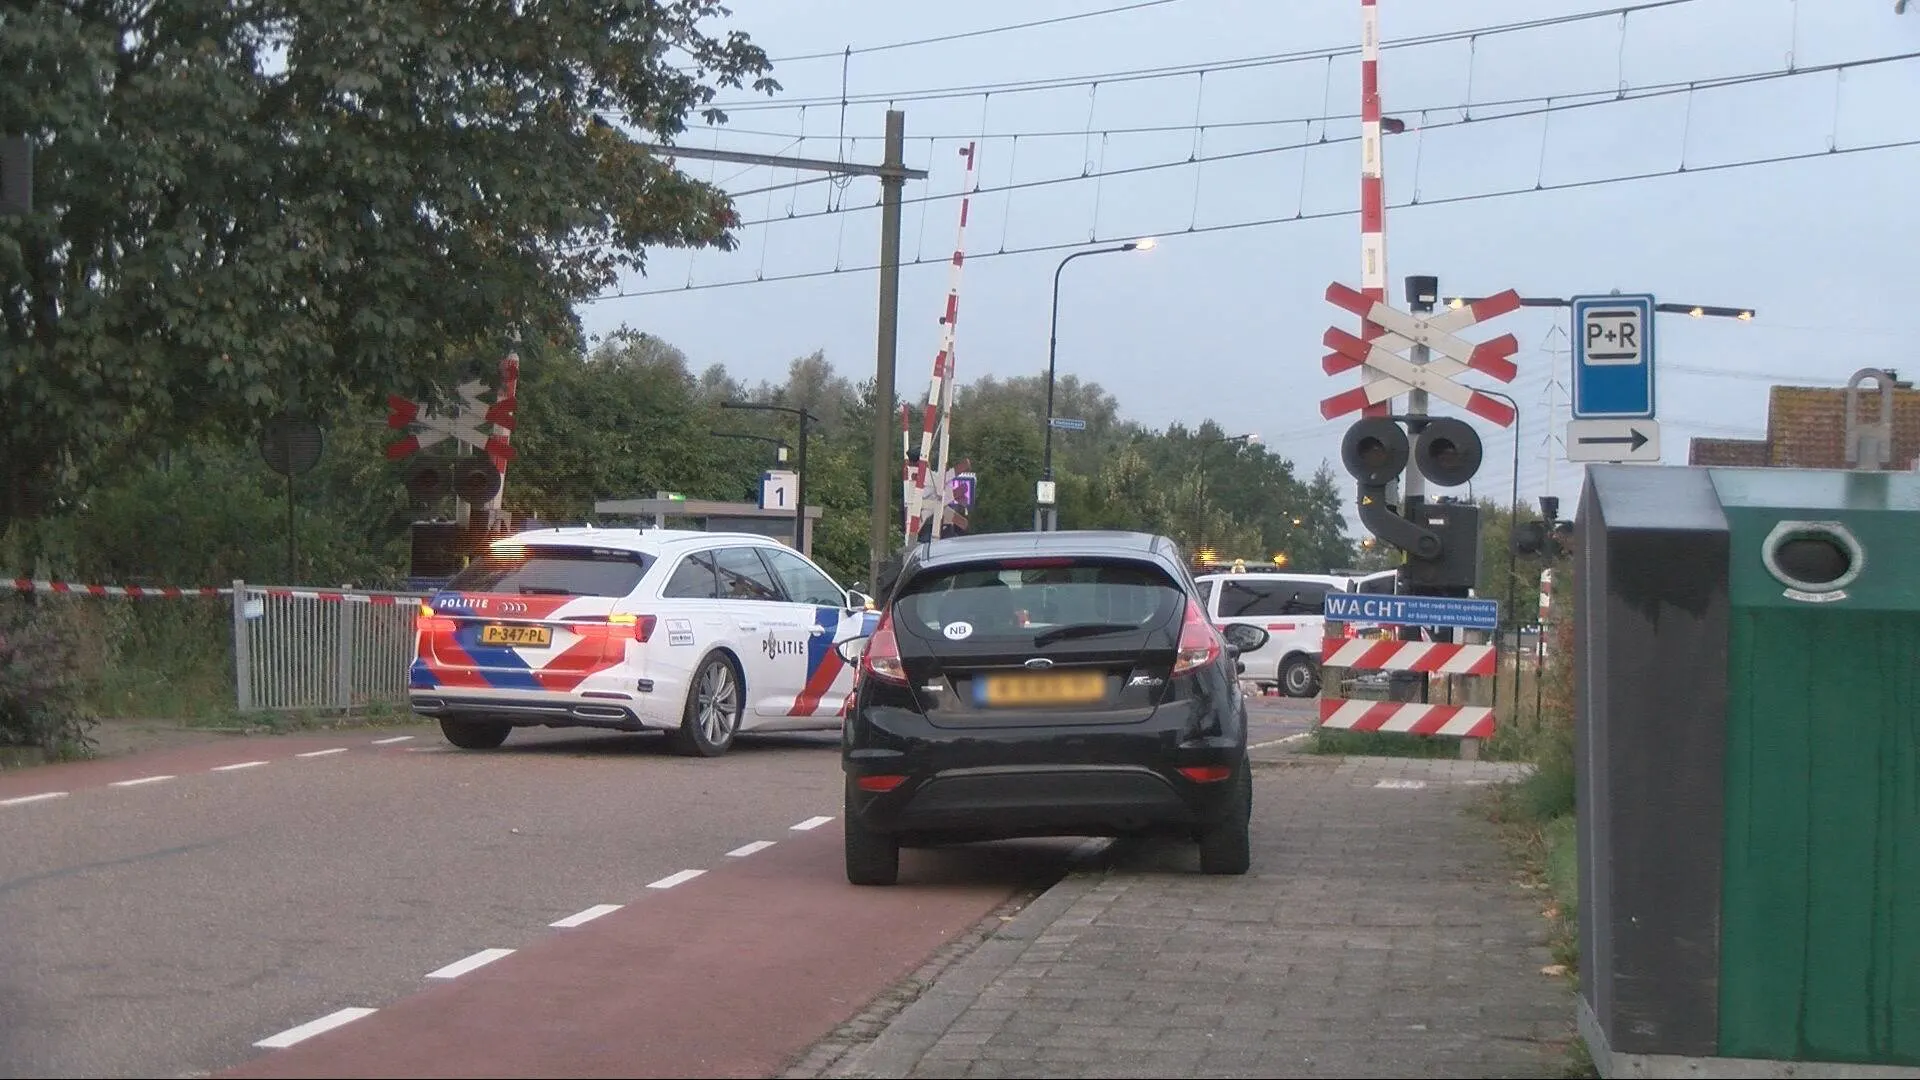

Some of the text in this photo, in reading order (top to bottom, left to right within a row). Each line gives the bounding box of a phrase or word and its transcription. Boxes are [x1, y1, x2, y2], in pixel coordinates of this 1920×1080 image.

[1587, 322, 1637, 348] P+R
[775, 486, 784, 507] 1
[440, 598, 489, 609] POLITIE
[1327, 598, 1406, 618] WACHT
[489, 627, 545, 643] P-347-PL
[950, 626, 967, 635] NB
[762, 638, 804, 659] POLITIE
